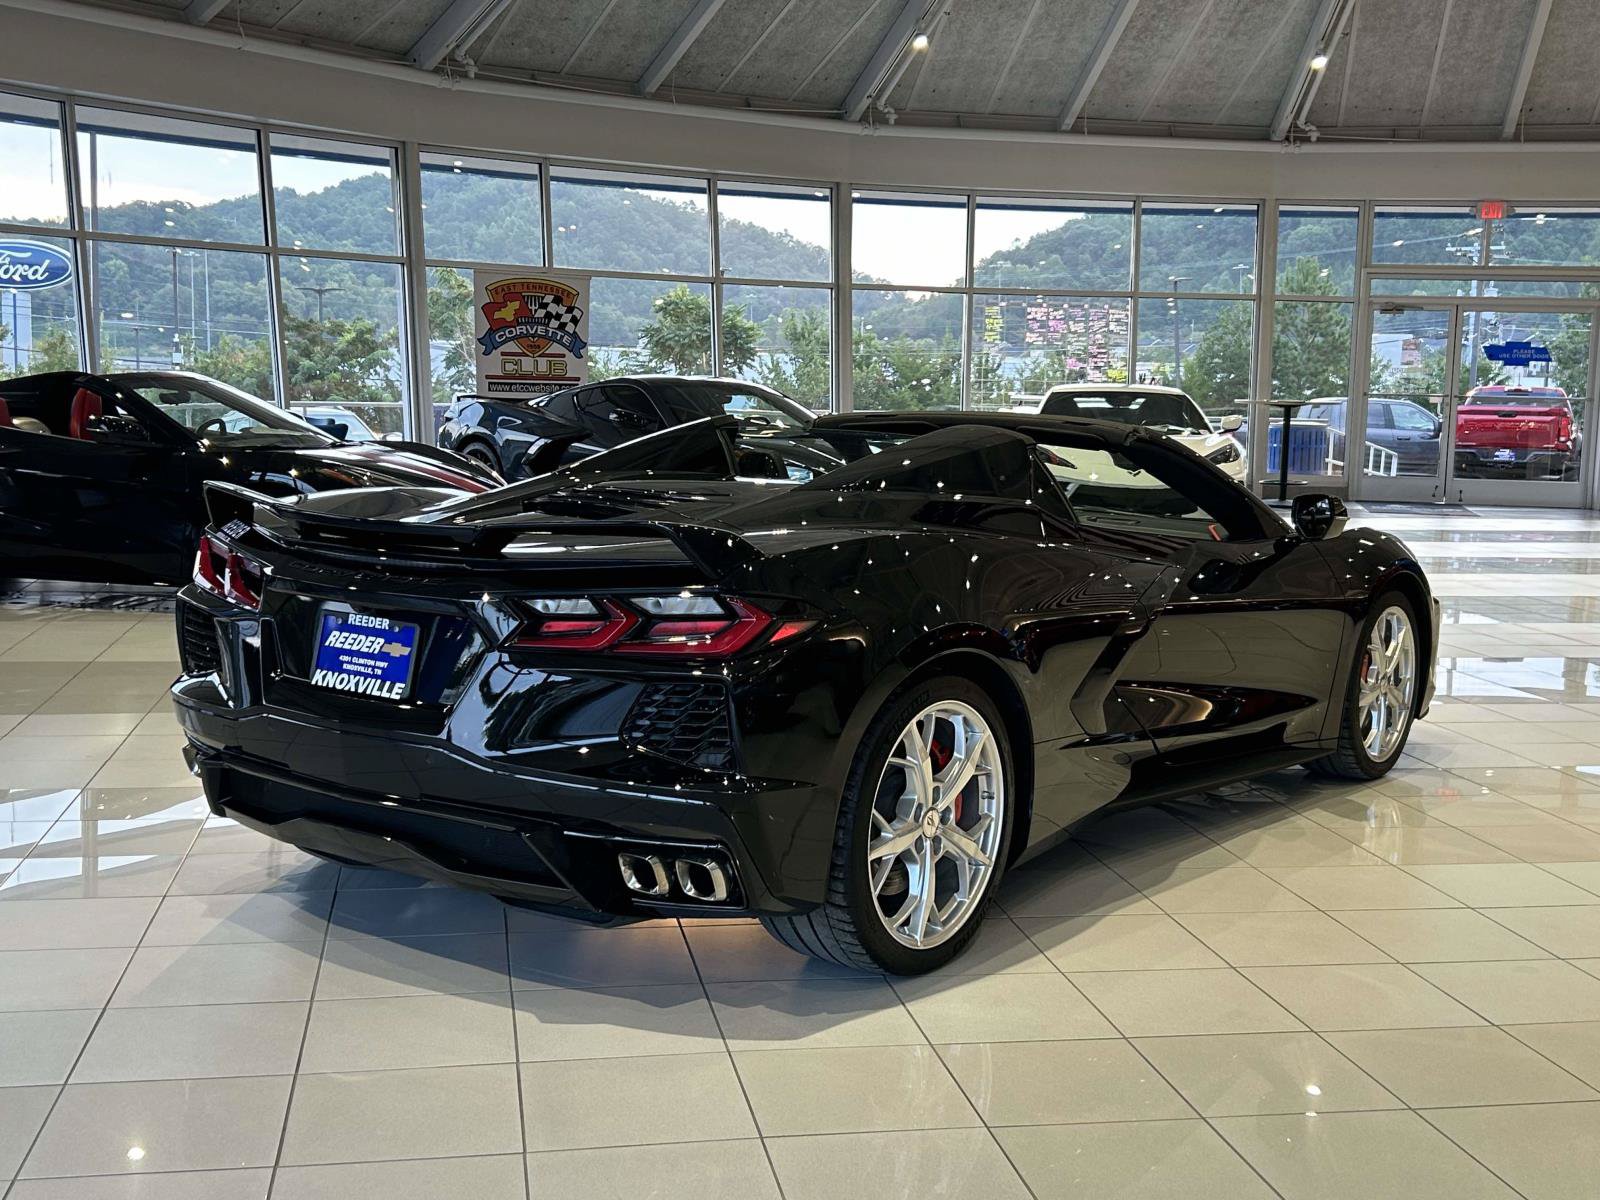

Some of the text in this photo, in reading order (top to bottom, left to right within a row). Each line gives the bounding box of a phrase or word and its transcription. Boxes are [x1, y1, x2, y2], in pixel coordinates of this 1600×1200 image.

[495, 284, 517, 295] EAST
[495, 325, 573, 346] CORVETTE
[500, 358, 568, 376] CLUB
[489, 383, 576, 393] www.etccwebsite.co
[348, 613, 390, 630] REEDER
[324, 630, 385, 654] REEDER
[352, 656, 375, 666] CLINTON
[375, 660, 389, 668] HWY
[311, 668, 406, 700] KNOXVILLE
